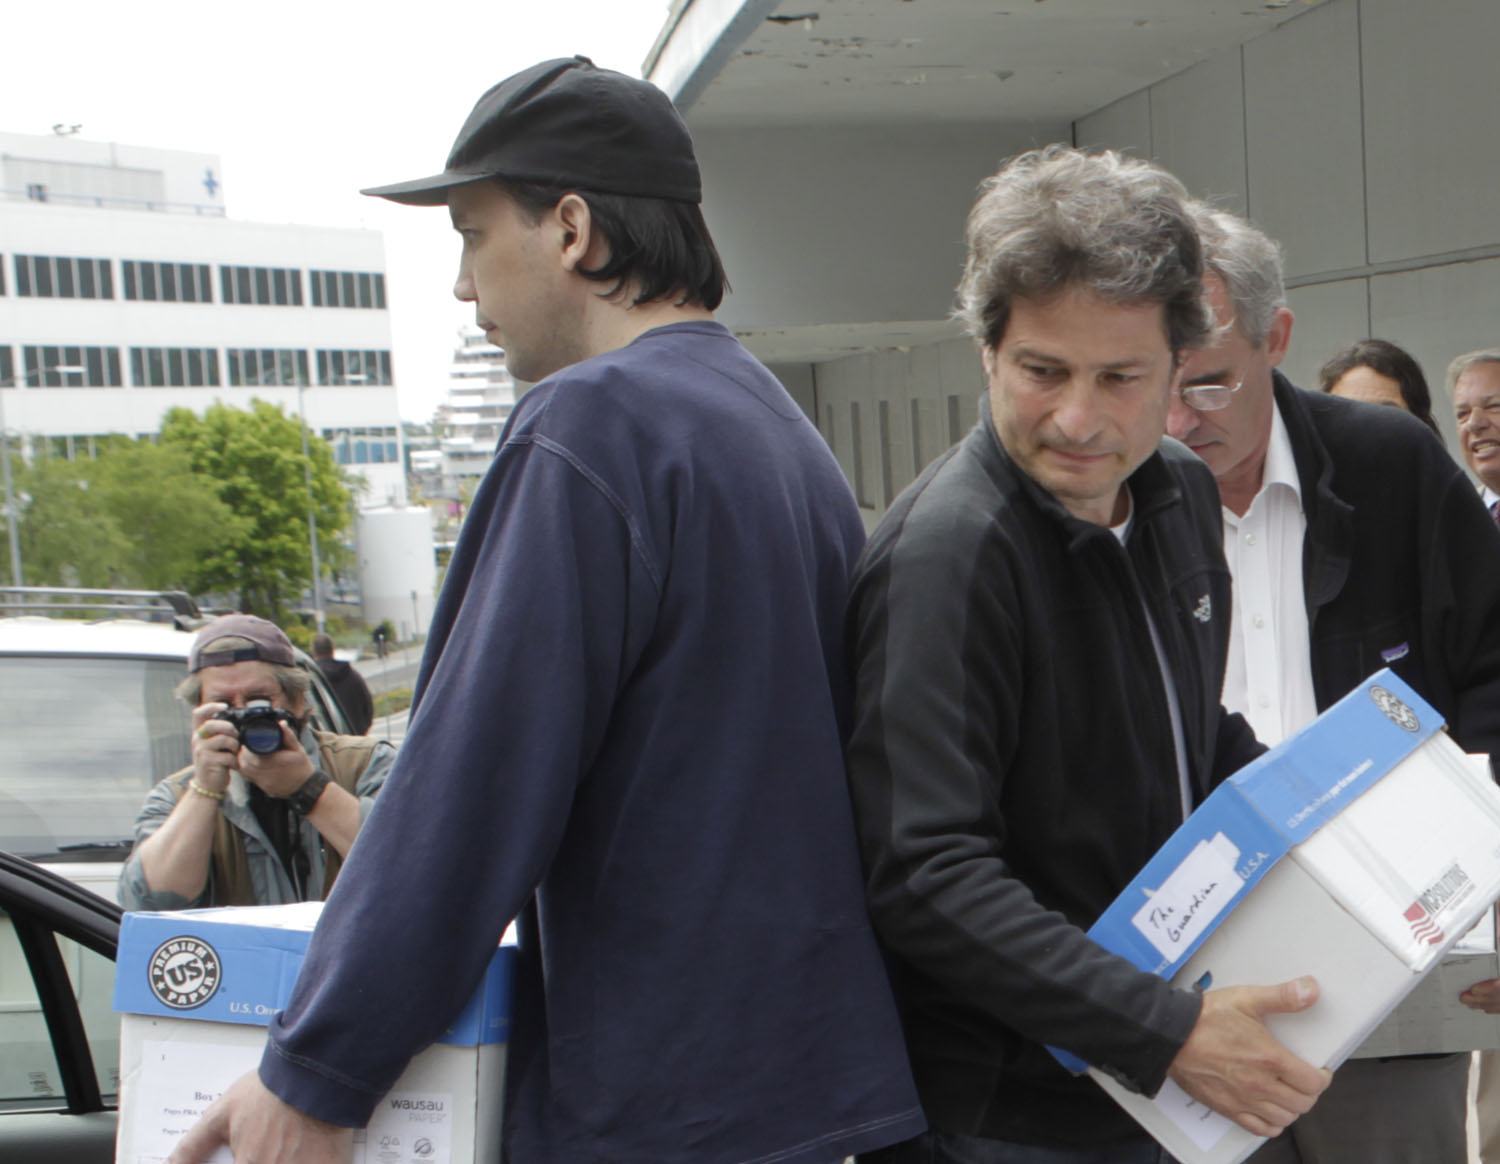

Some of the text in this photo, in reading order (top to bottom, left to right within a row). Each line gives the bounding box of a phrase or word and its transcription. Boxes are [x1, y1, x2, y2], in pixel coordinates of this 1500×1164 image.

[1149, 906, 1175, 929] The
[1166, 882, 1219, 943] Guardian
[152, 940, 209, 977] PREMIUM
[165, 957, 204, 987] US
[166, 976, 216, 1005] PAPER
[195, 1091, 213, 1101] Box
[391, 1099, 444, 1112] wausau
